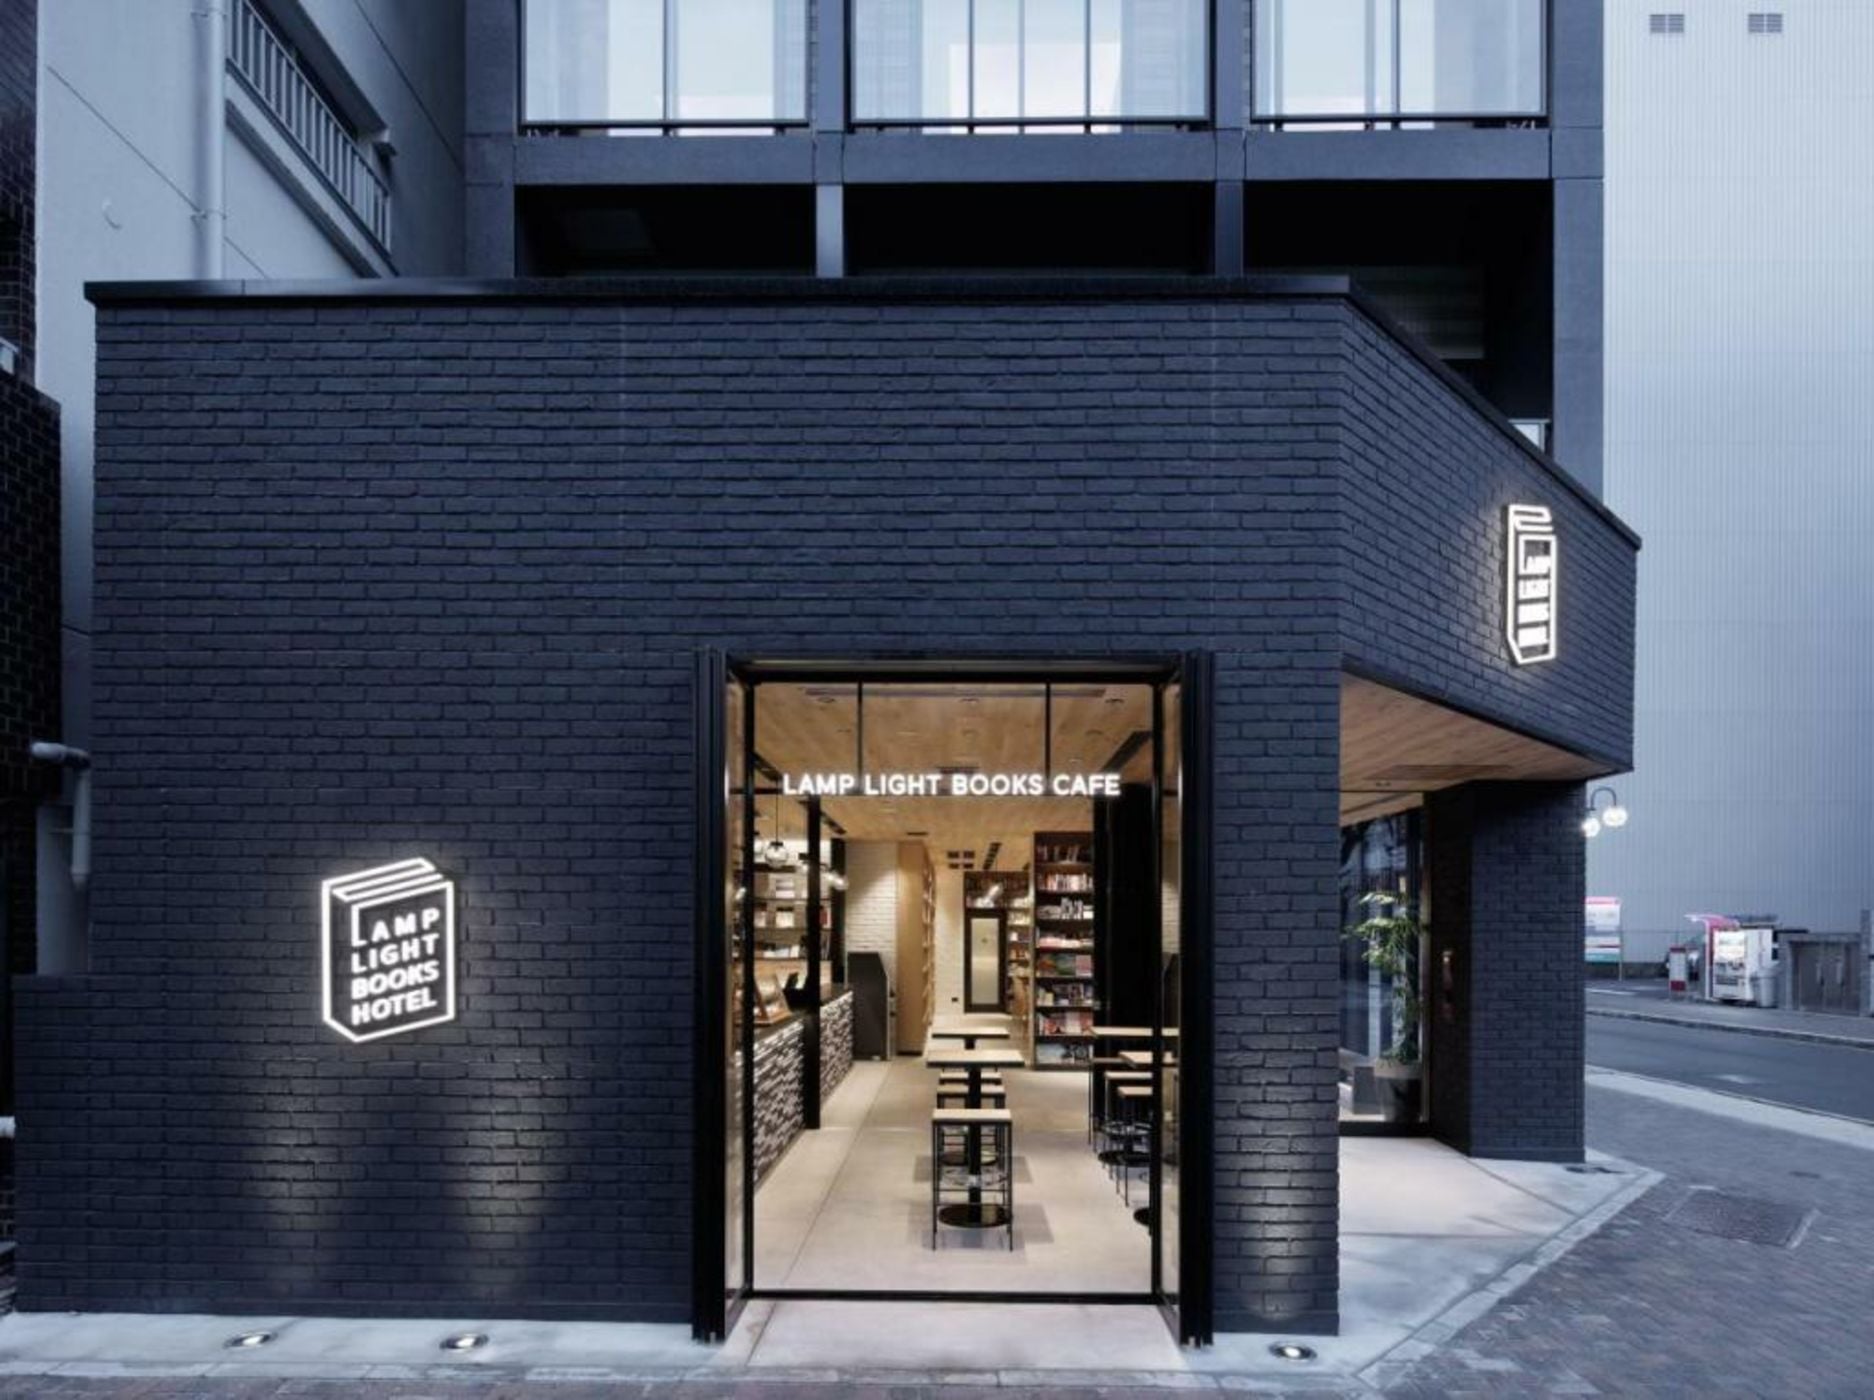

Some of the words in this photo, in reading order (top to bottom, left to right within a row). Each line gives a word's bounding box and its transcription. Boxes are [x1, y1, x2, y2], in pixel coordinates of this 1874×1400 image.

[782, 774, 855, 796] LAMP
[864, 774, 942, 796] LIGHT
[951, 774, 1044, 796] BOOKS
[1051, 774, 1121, 796] CAFE
[351, 905, 440, 947] LAMP
[351, 933, 440, 974] LIGHT
[351, 960, 440, 1000] BOOKS
[351, 987, 438, 1026] HOTEL
